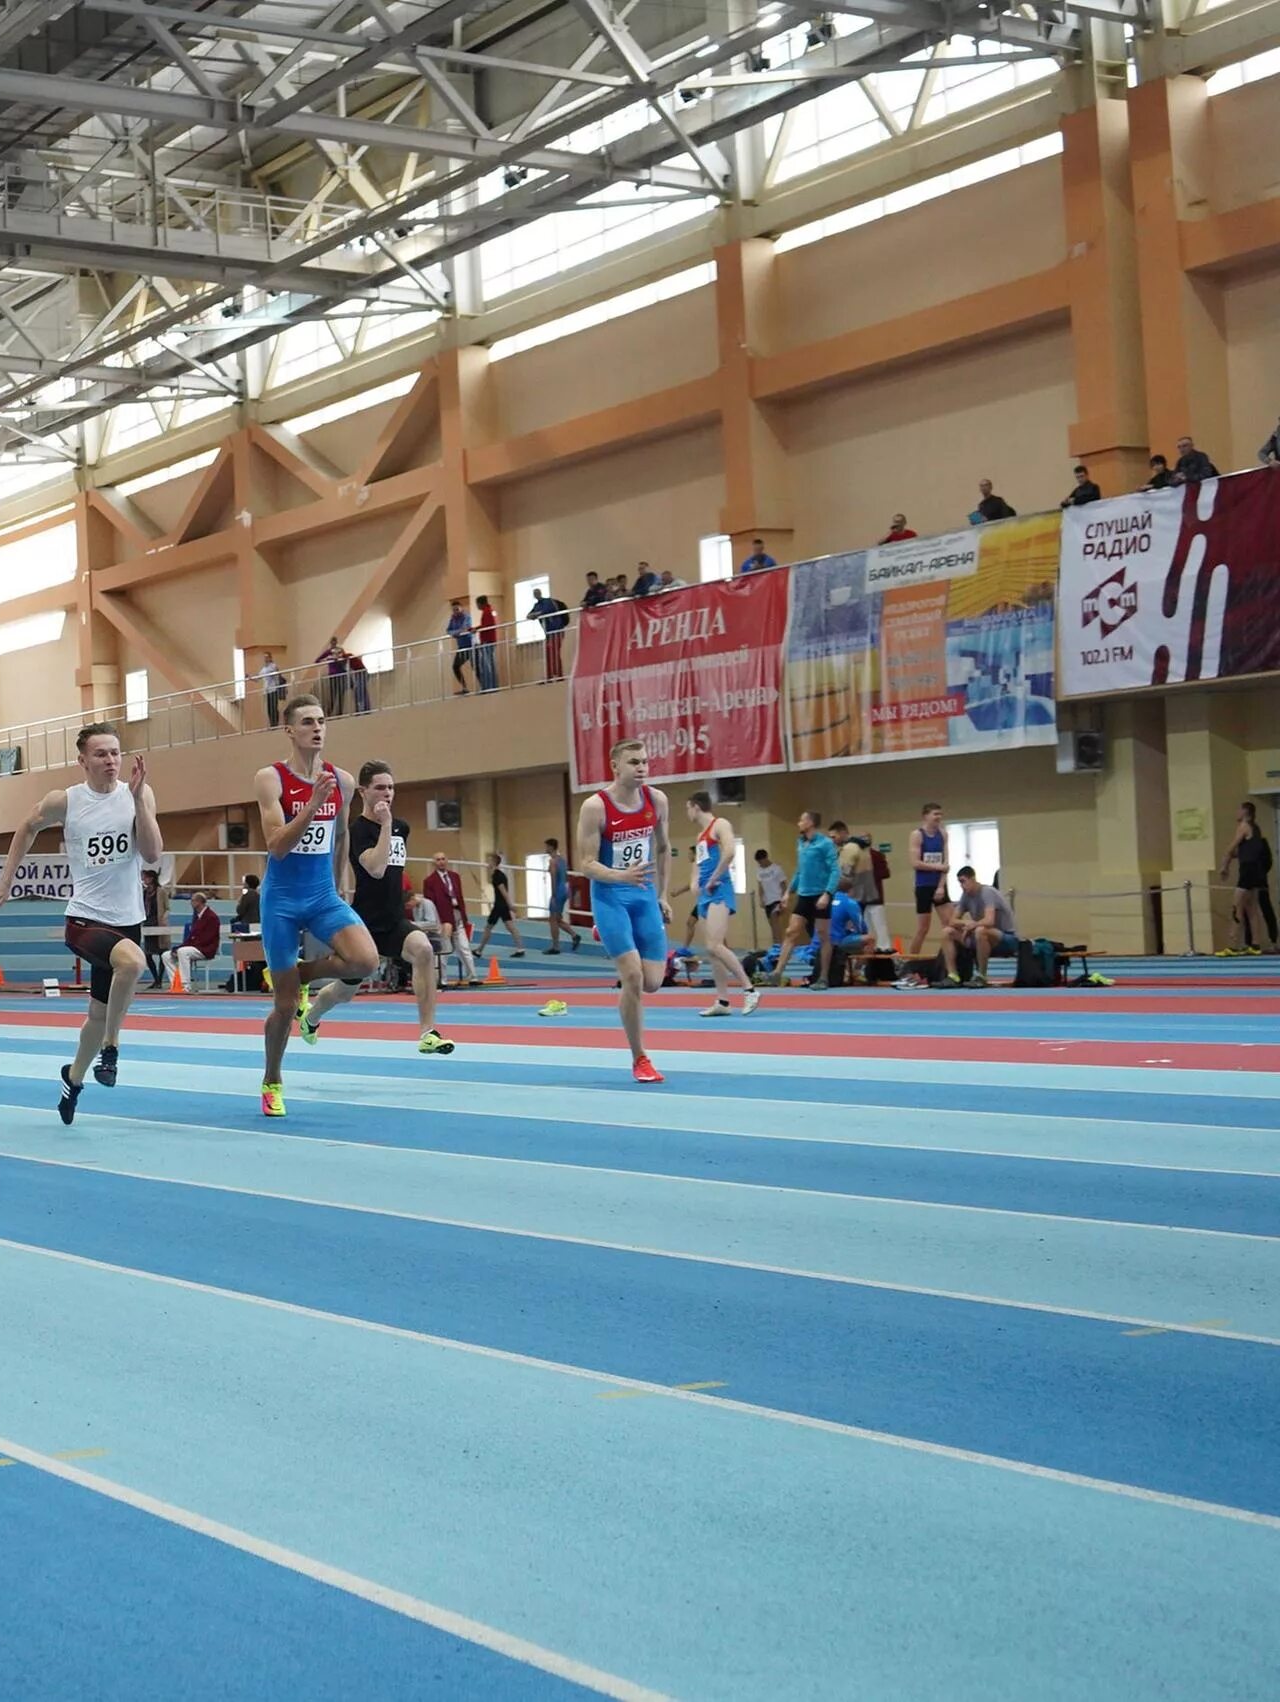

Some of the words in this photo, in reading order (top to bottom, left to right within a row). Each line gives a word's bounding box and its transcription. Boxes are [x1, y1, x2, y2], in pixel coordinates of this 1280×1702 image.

[1085, 510, 1153, 539] СЛУШАЙ
[1083, 533, 1151, 561] РАДИО
[626, 606, 727, 650] АРЕНДА
[1080, 648, 1110, 666] 102.1
[1112, 644, 1133, 662] FM
[871, 706, 897, 721] МЫ
[901, 699, 957, 719] РЯДОМ!
[292, 801, 336, 816] RUSIA
[87, 833, 128, 858] 596
[301, 826, 325, 845] 59
[622, 843, 643, 862] 96
